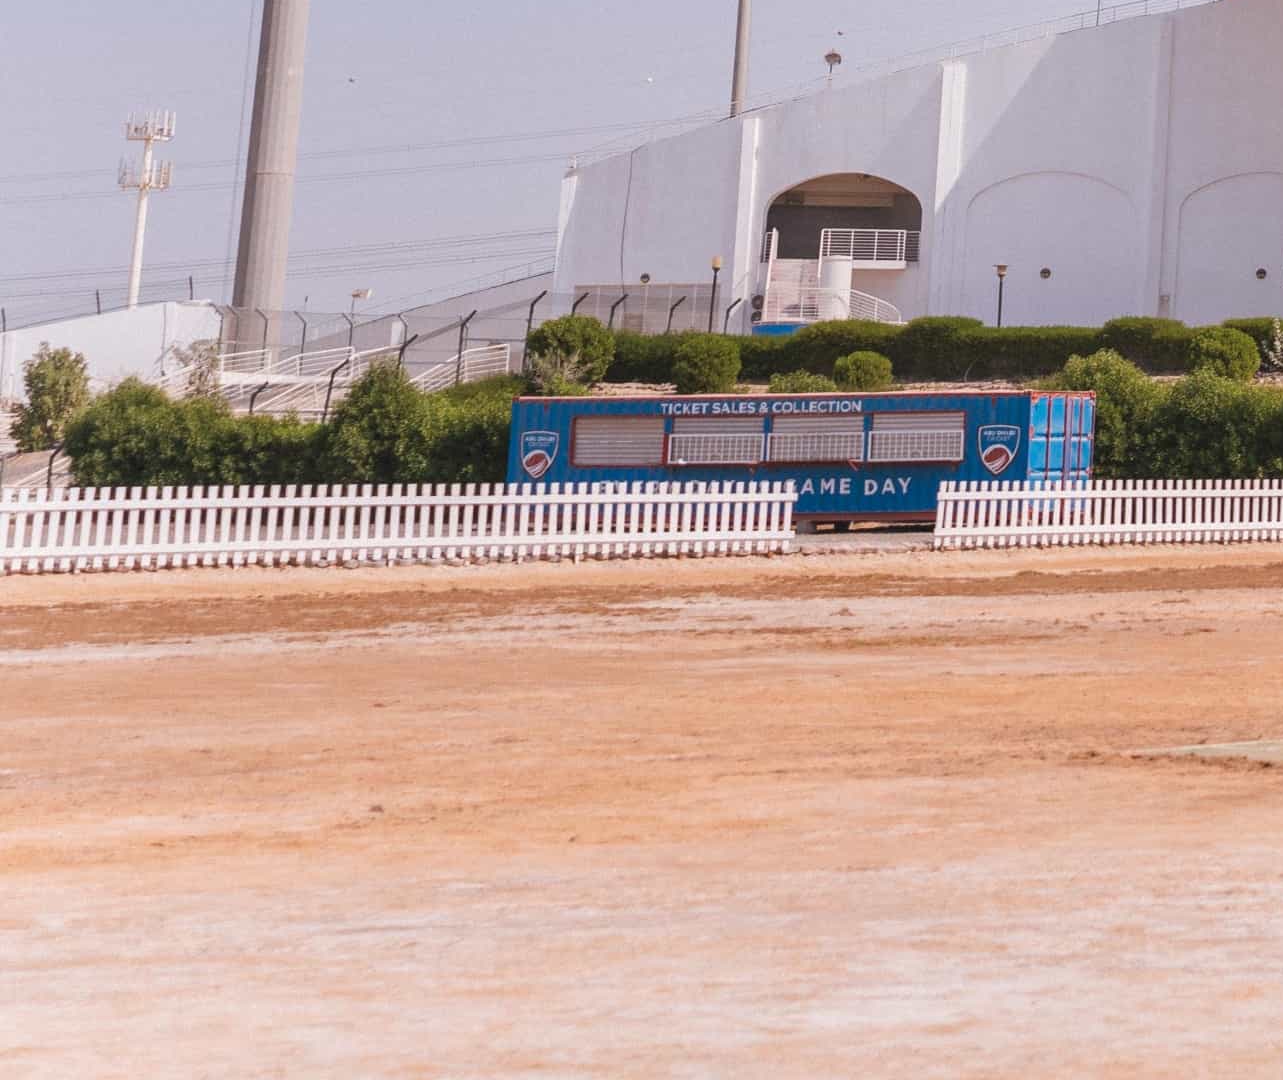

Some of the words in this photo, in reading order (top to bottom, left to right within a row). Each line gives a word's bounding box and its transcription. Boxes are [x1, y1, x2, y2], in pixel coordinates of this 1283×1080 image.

[661, 402, 708, 415] TICKET
[712, 401, 755, 414] SALES
[759, 400, 769, 413] &
[772, 399, 862, 413] COLLECTION
[864, 477, 912, 495] DAY
